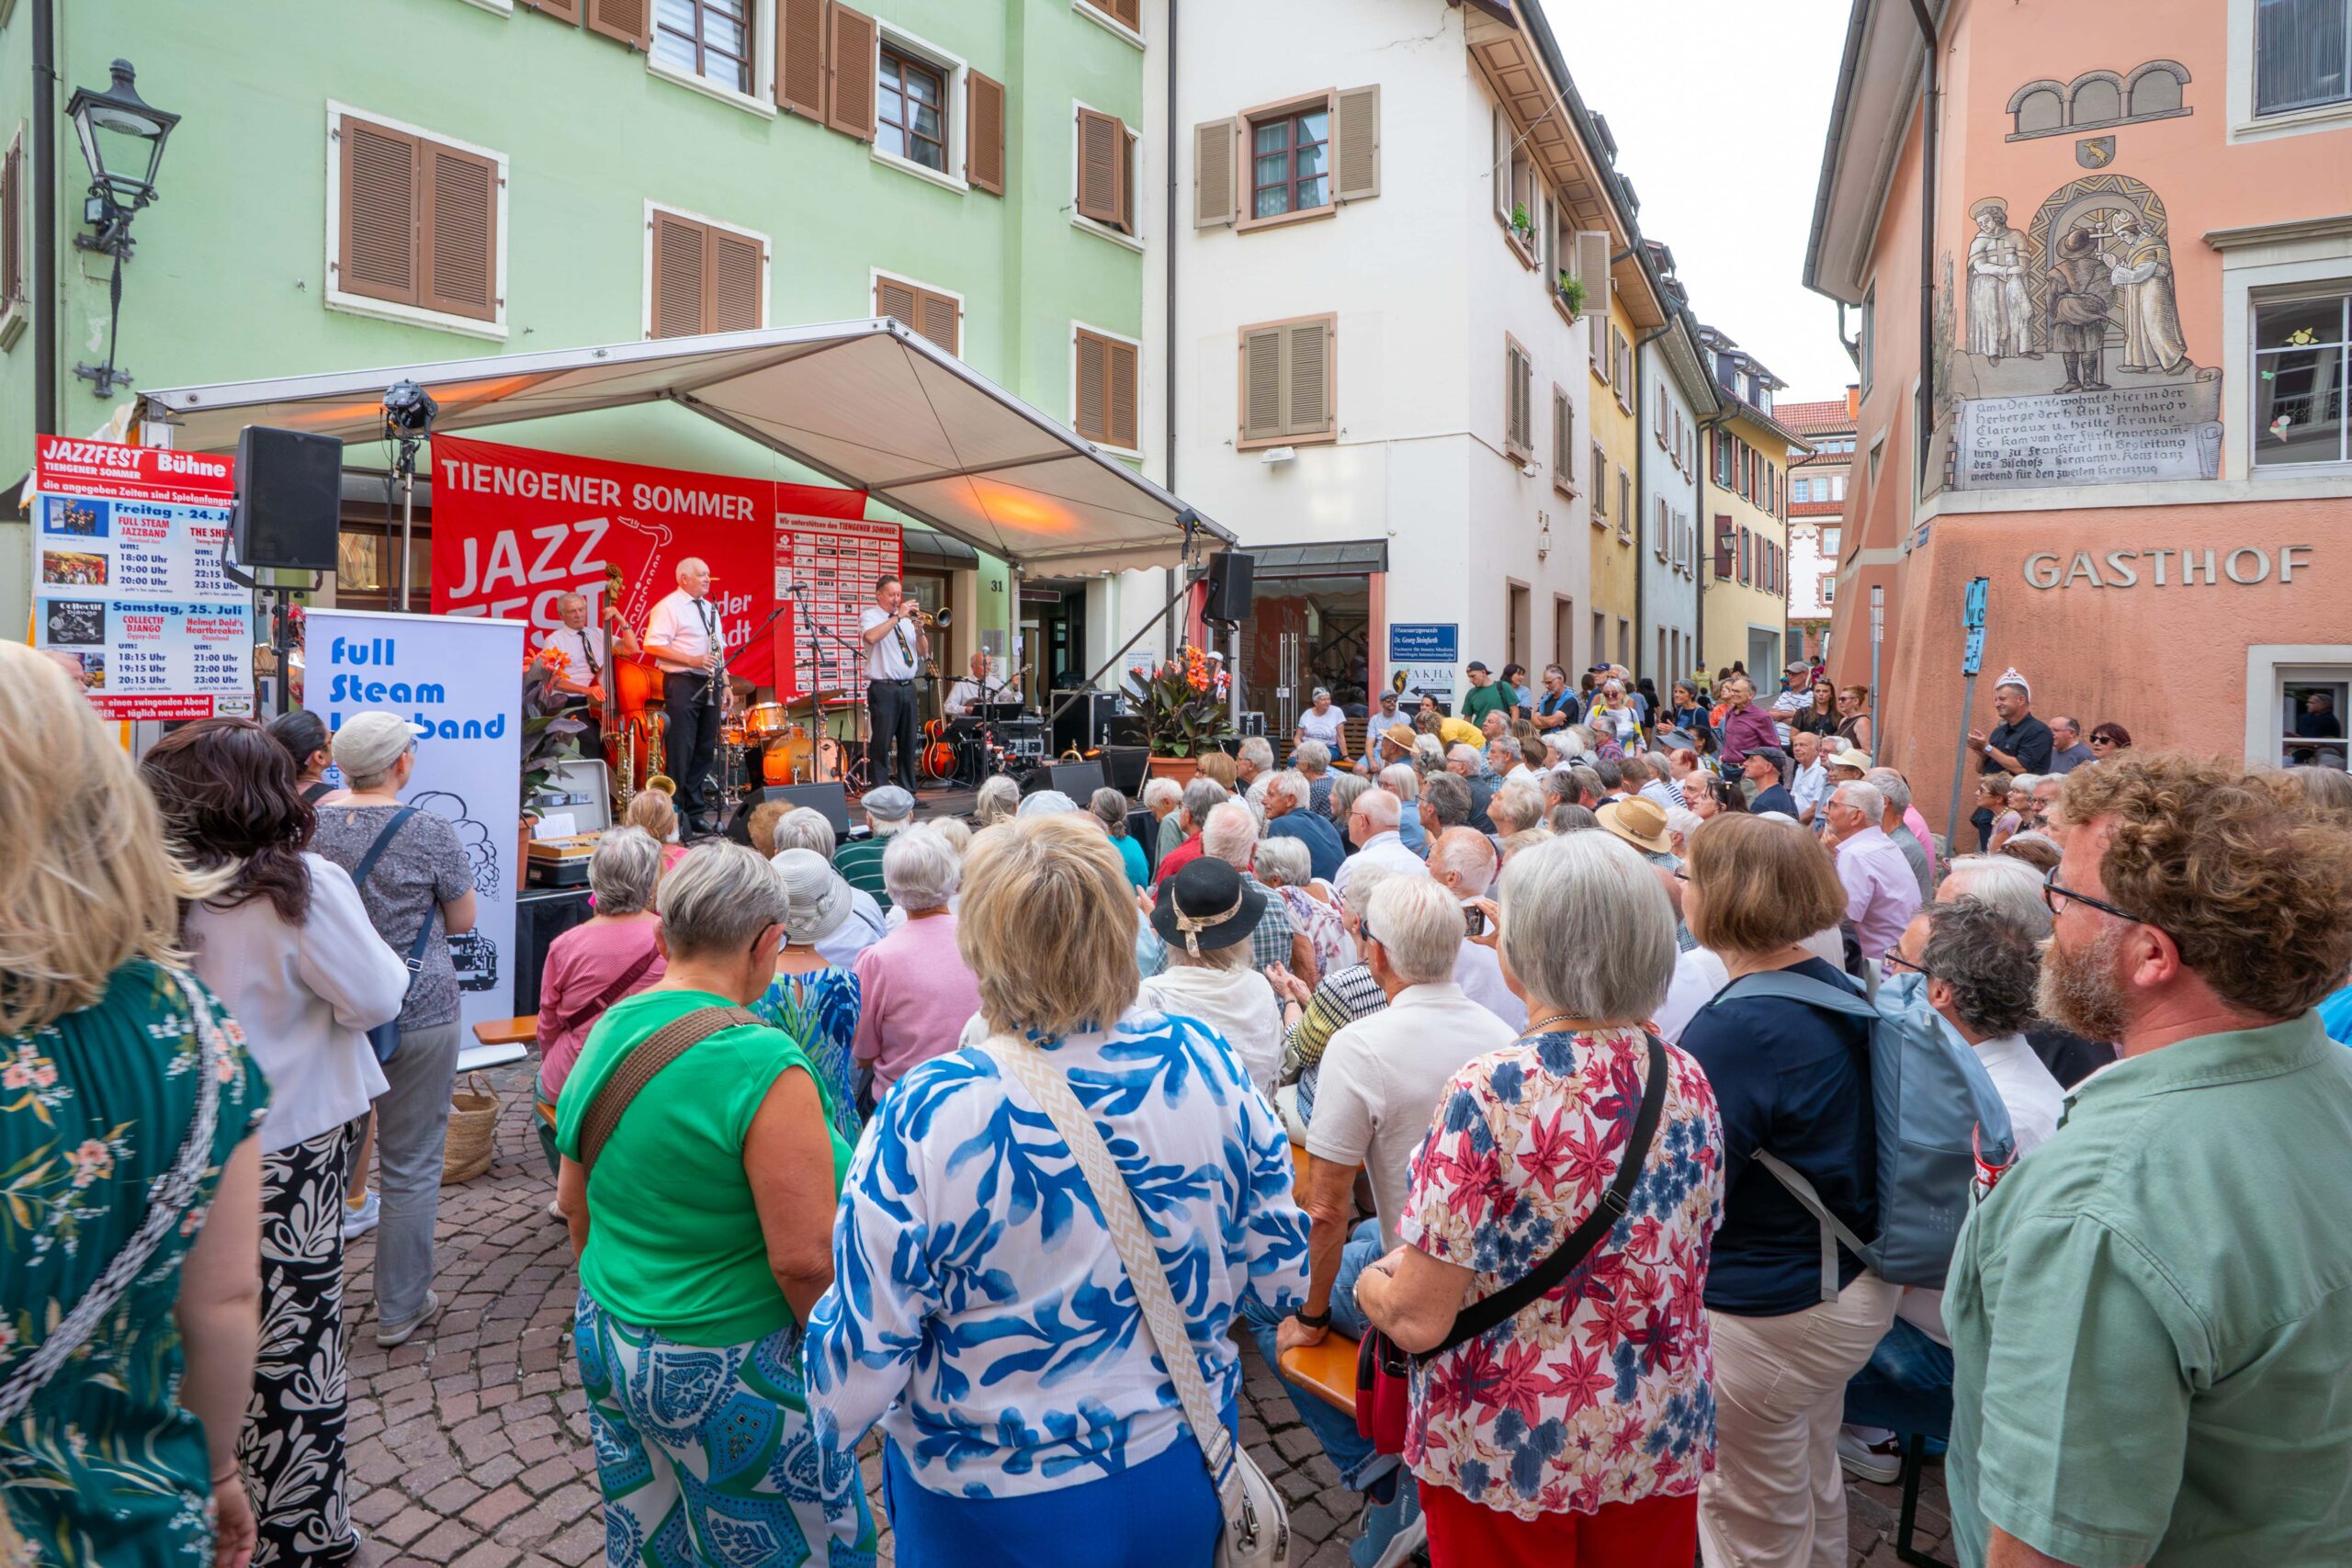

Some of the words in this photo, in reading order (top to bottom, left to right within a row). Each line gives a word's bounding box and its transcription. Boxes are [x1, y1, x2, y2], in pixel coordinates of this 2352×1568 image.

[2059, 394, 2108, 407] wohnte
[2113, 391, 2141, 401] hier
[2144, 390, 2159, 400] in
[2161, 389, 2184, 399] der
[1975, 412, 2035, 424] Herberge
[2038, 410, 2060, 419] der
[2105, 401, 2174, 415] Bernhard
[1975, 424, 2046, 435] Clairvaux
[1976, 436, 1992, 448] Er
[2030, 434, 2051, 443] von
[2053, 433, 2076, 443] der
[2008, 448, 2022, 457] zu
[2098, 442, 2111, 451] in
[2115, 439, 2186, 451] Begleitung
[42, 439, 144, 469] JAZZFEST
[157, 453, 226, 478] Bühne
[1973, 460, 1993, 469] des
[43, 462, 98, 476] TIENGENER
[99, 468, 141, 479] SOMMER
[1971, 470, 2013, 481] werbend
[2016, 469, 2031, 479] für
[2035, 468, 2054, 479] den
[43, 479, 60, 490] die
[62, 483, 118, 495] angegeben
[119, 487, 149, 499] Zeiten
[151, 491, 170, 501] sind
[172, 491, 232, 507] Spielanfangsz
[441, 458, 622, 507] TIENGENER
[632, 483, 755, 522] SOMMER
[115, 502, 172, 519] Freitag
[189, 509, 212, 521] 24.
[118, 516, 139, 526] FULL
[141, 518, 170, 528] STEAM
[120, 527, 166, 538] JAZZBAND
[189, 527, 207, 537] THE
[839, 522, 871, 532] TIENGENER
[872, 525, 898, 536] SOMMER:
[120, 553, 148, 562] 18:00
[151, 555, 168, 564] Uhr
[194, 558, 220, 568] 21:15
[448, 517, 610, 599] JAZZ
[120, 565, 148, 573] 19:00
[151, 566, 168, 575] Uhr
[2022, 544, 2313, 590] GASTHOF
[194, 570, 220, 579] 22:15
[119, 576, 148, 585] 20:00
[151, 578, 168, 586] Uhr
[194, 581, 220, 589] 23:15
[223, 581, 239, 590] Uhr
[990, 580, 1003, 592] 31
[113, 602, 184, 615] Samstag,
[188, 604, 212, 615] 25.
[217, 605, 243, 615] Juli
[717, 590, 752, 617] der
[67, 609, 97, 617] Django
[1968, 607, 1984, 623] WC
[122, 615, 165, 625] COLLECTIF
[187, 617, 217, 626] Helmut
[219, 618, 243, 627] Dold's
[127, 625, 161, 633] DJANGO
[186, 626, 244, 635] Heartbreakers
[127, 633, 161, 641] Gypsy-Jazz
[119, 653, 147, 661] 18:15
[149, 653, 166, 661] Uhr
[119, 664, 147, 672] 19:15
[149, 664, 166, 672] Uhr
[1412, 670, 1453, 678] AKHA
[118, 676, 147, 684] 20:15
[149, 676, 166, 684] Uhr
[194, 676, 220, 684] 23:00
[222, 676, 239, 684] Uhr
[330, 673, 445, 704] Steam
[108, 698, 132, 706] einen
[133, 698, 182, 708] swingenden
[184, 697, 209, 706] Abend
[128, 709, 156, 719] täglich
[330, 712, 505, 740] Jband
